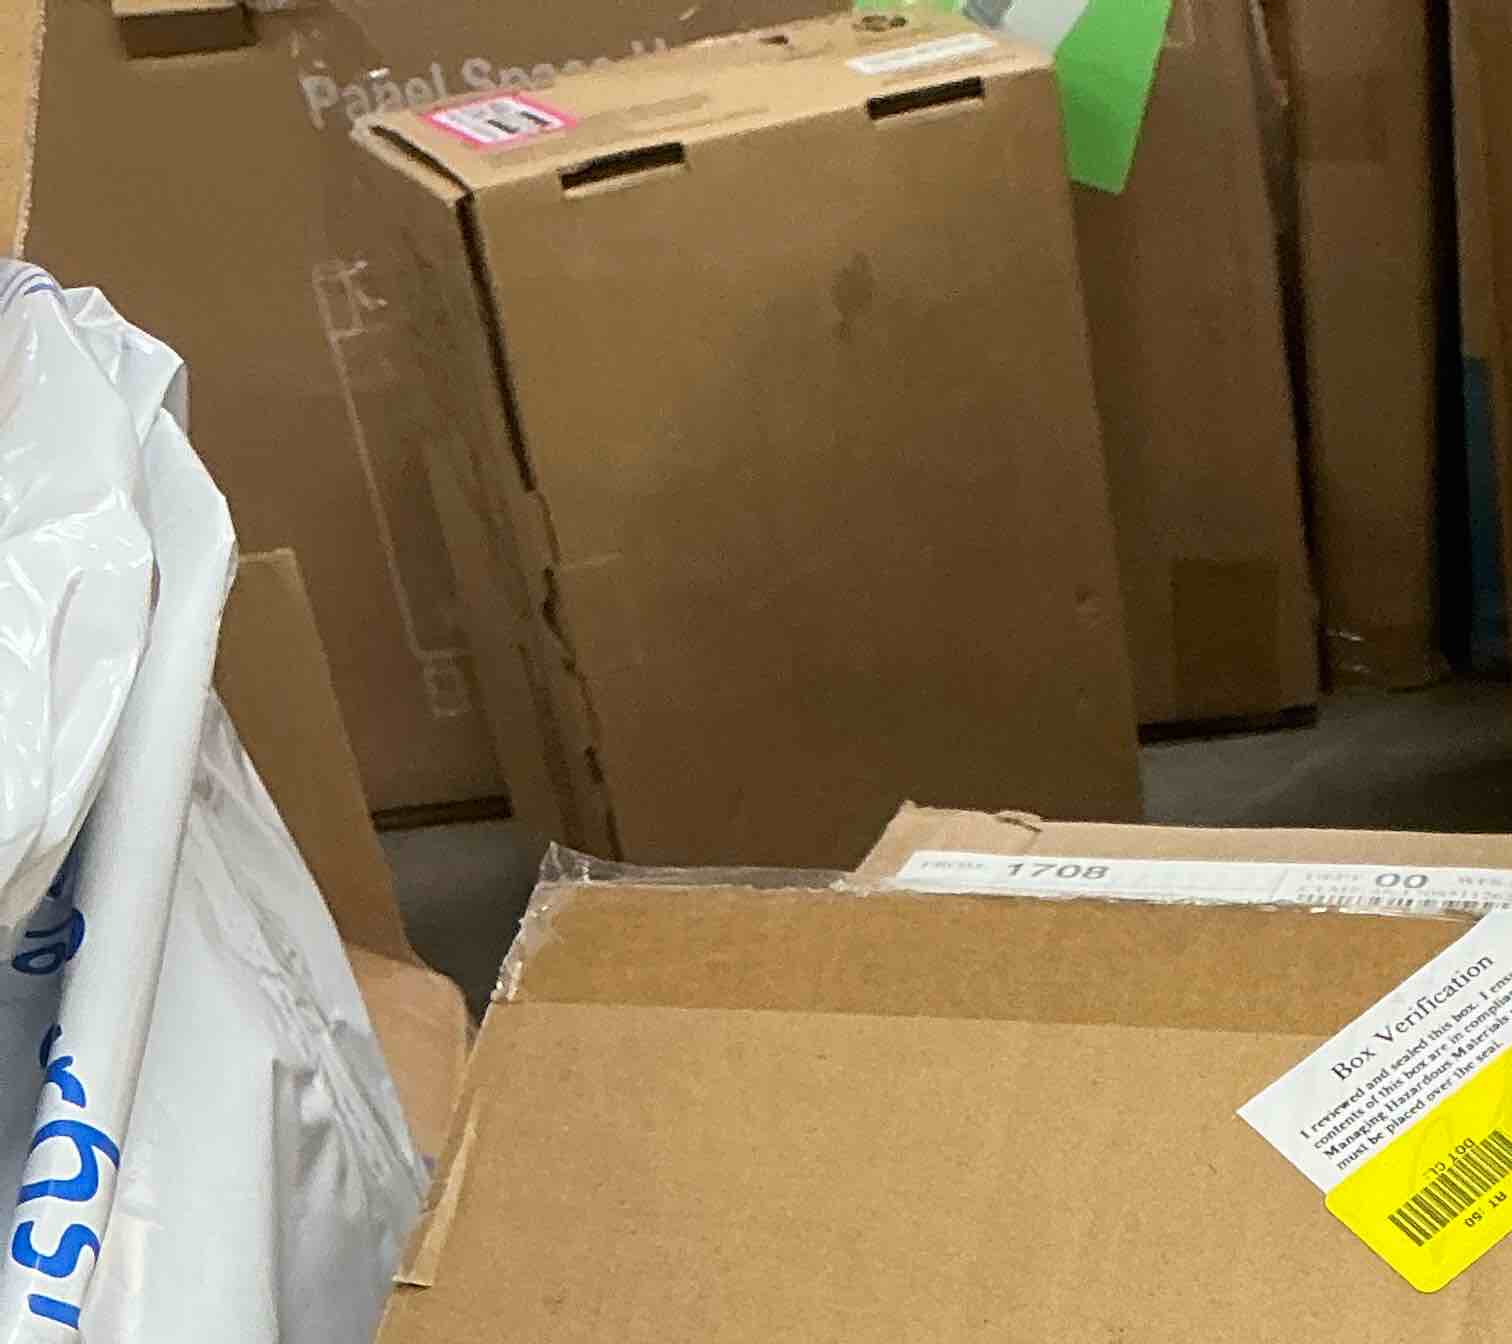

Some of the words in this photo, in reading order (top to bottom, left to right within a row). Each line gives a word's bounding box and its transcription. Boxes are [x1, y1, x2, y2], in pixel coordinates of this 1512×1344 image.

[1008, 863, 1110, 880] 1708
[1376, 873, 1428, 889] 00
[1310, 1086, 1365, 1132] reviewed
[1365, 1067, 1390, 1090] and
[1390, 1037, 1428, 1070] sealed
[1427, 1021, 1453, 1041] this
[1450, 1002, 1479, 1022] box.
[1330, 1047, 1376, 1081] Box
[1372, 956, 1494, 1042] Verification
[1313, 1108, 1365, 1149] contents
[1365, 1093, 1379, 1109] of
[1377, 1078, 1404, 1097] this
[1401, 1059, 1428, 1079] box
[1426, 1043, 1447, 1061] are
[1449, 1032, 1464, 1044] in
[1322, 1111, 1388, 1156] Managing
[1383, 1060, 1453, 1112] Hazardous
[1450, 1015, 1509, 1058] Materials
[1336, 1143, 1369, 1170] must
[1366, 1131, 1385, 1145] be
[1384, 1098, 1425, 1135] placed
[1425, 1077, 1452, 1102] over
[1452, 1061, 1474, 1079] the
[1447, 1137, 1476, 1163] DOT
